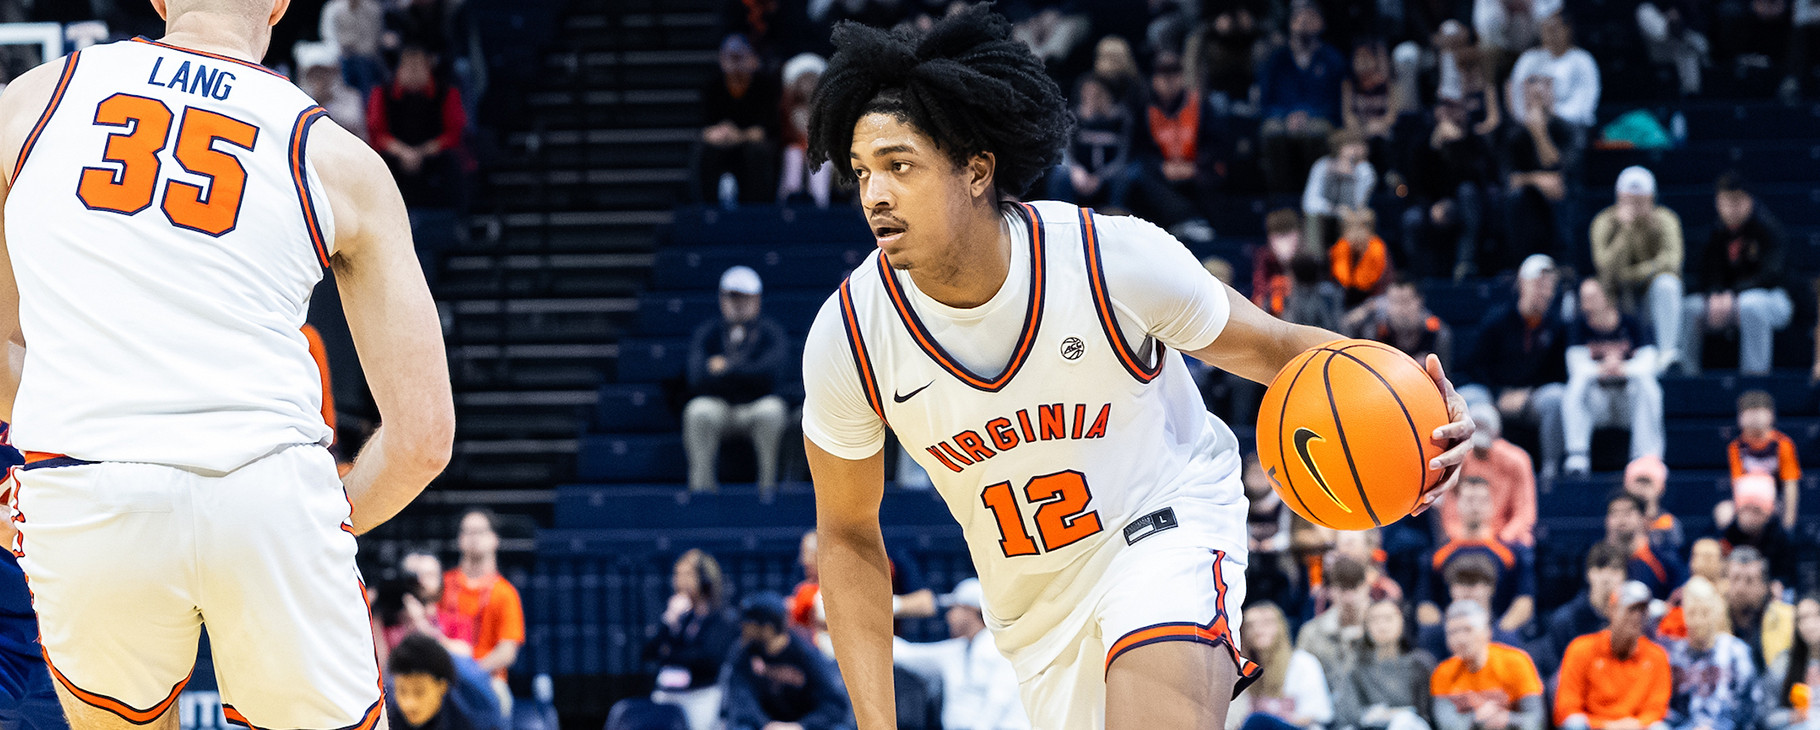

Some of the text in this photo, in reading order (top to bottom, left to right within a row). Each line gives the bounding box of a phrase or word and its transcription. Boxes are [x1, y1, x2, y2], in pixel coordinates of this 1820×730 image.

[148, 56, 236, 101] LANG
[76, 92, 260, 238] 35
[1064, 341, 1082, 354] ACC
[925, 403, 1111, 473] VIRGINIA
[980, 469, 1104, 558] 12
[1158, 515, 1168, 524] L
